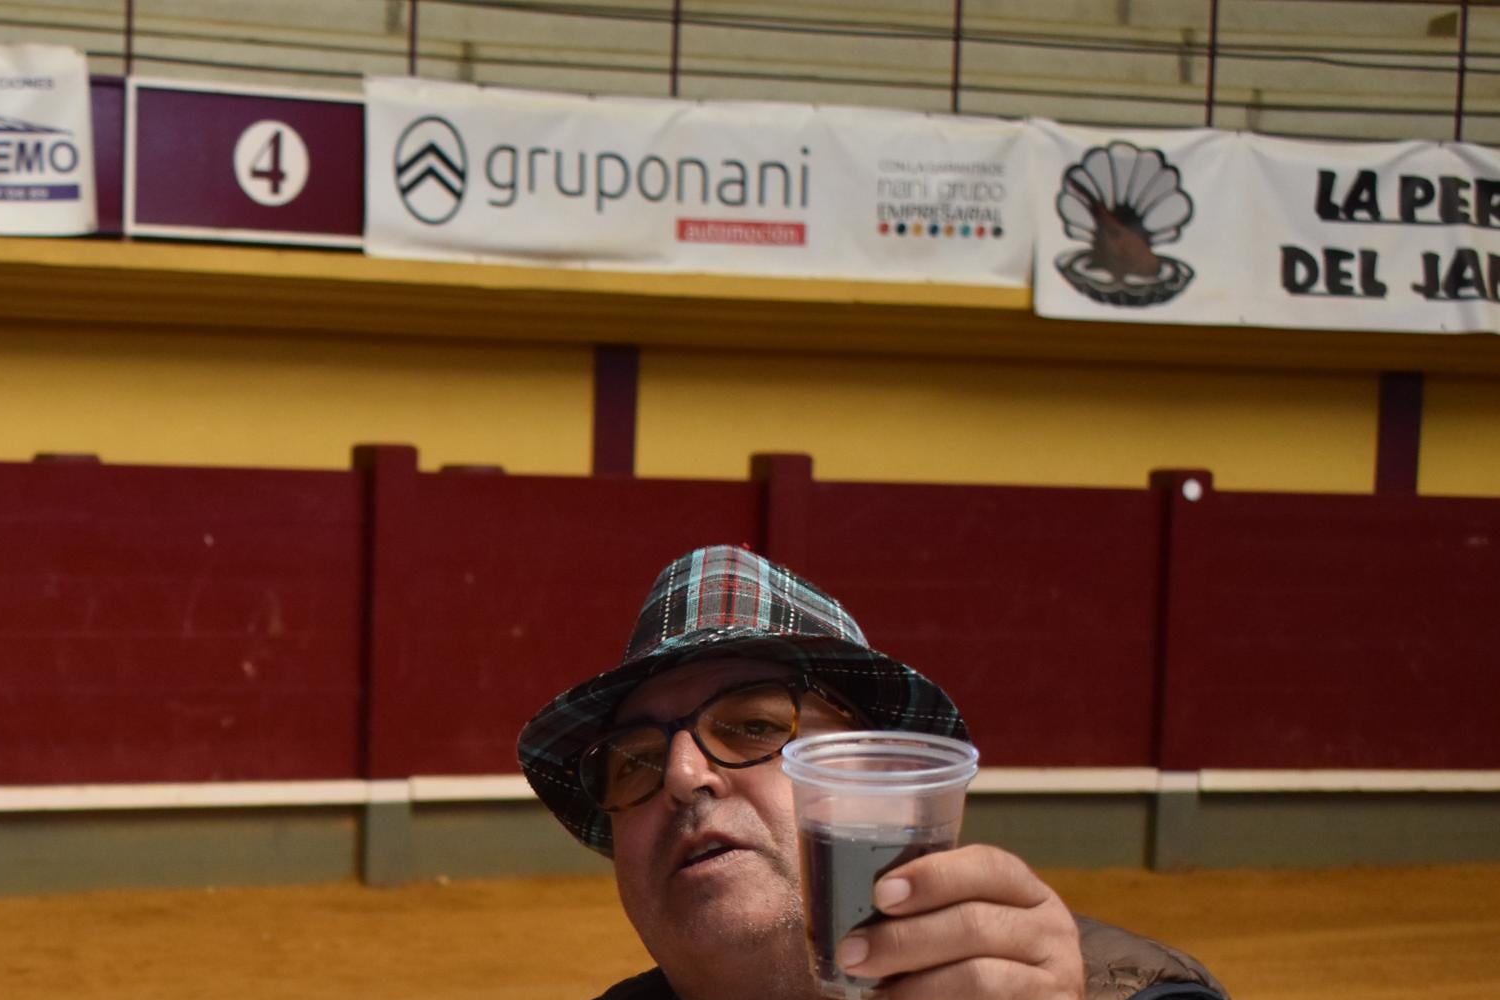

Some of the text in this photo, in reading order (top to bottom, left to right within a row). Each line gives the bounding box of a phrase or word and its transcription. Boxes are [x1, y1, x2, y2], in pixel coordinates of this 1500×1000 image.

[249, 128, 288, 195] 4
[484, 143, 811, 212] gruponani
[1315, 169, 1381, 221] LA
[1280, 245, 1388, 298] DEL
